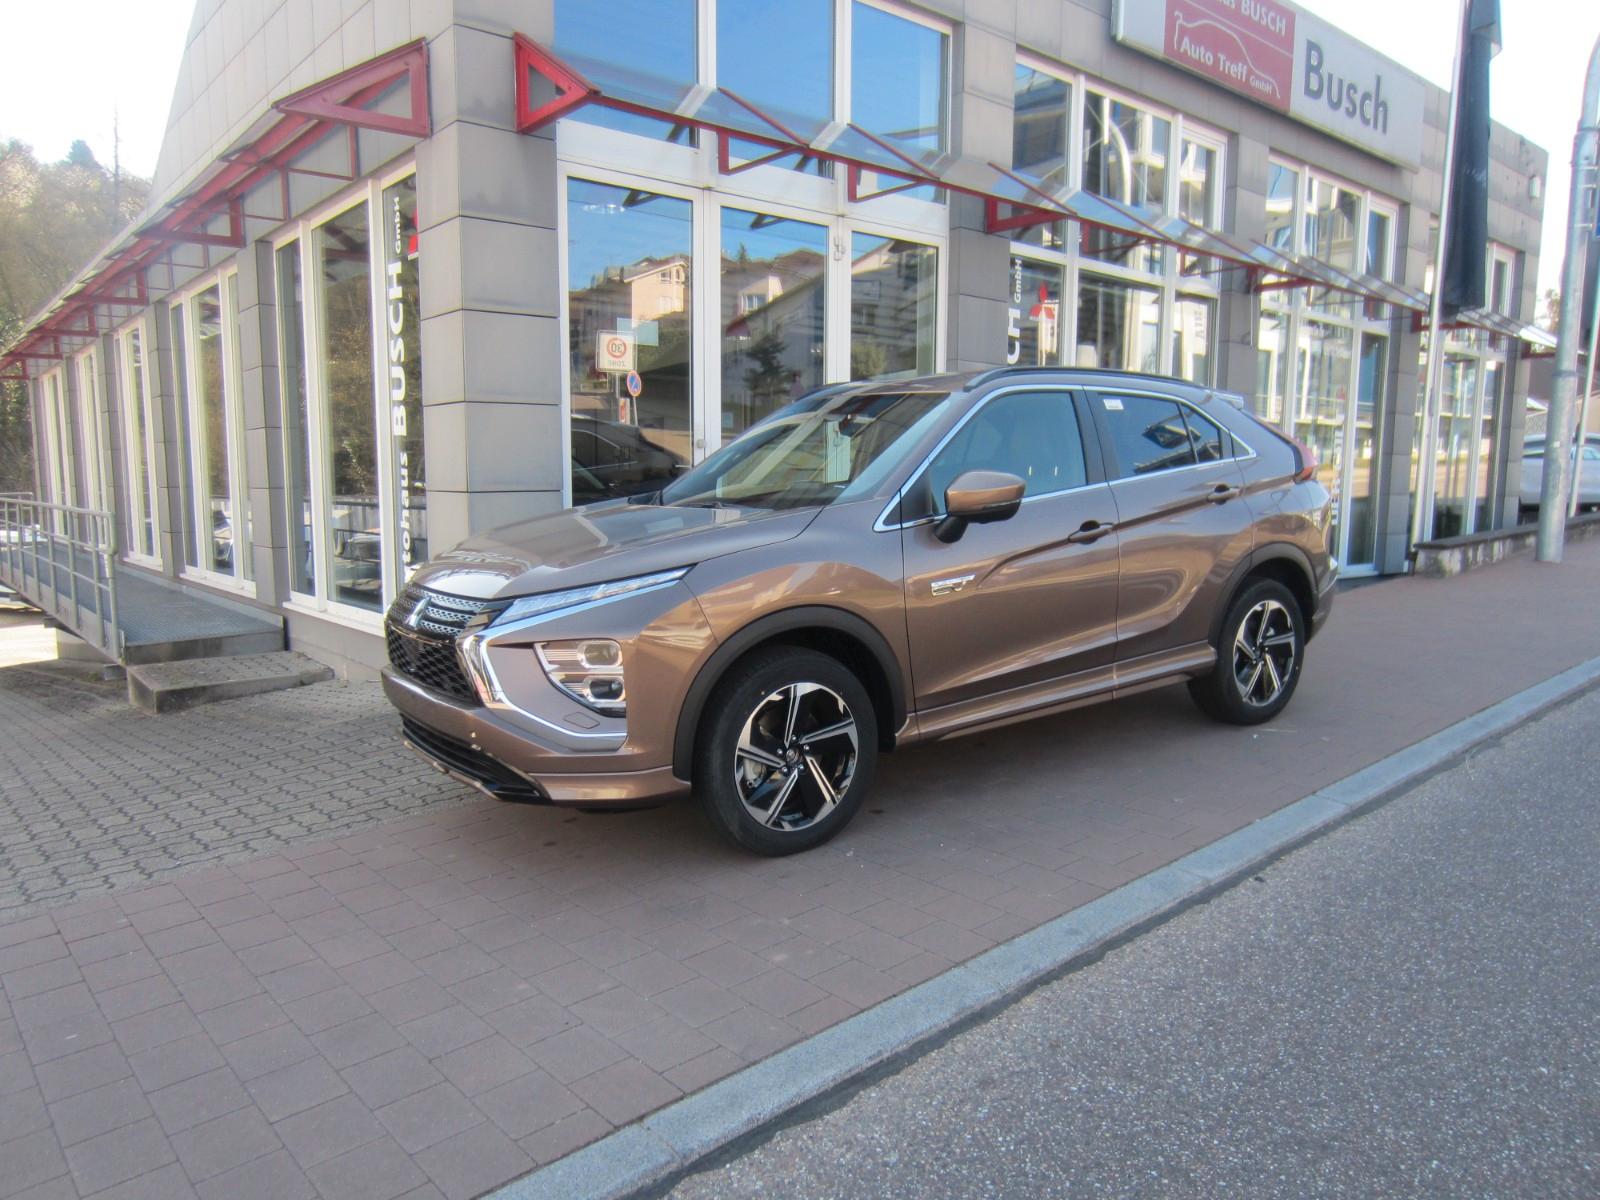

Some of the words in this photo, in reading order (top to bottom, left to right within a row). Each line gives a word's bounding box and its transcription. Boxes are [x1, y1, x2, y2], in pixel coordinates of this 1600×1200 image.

[1241, 0, 1286, 37] BUSCH
[1180, 35, 1214, 66] Auto
[1217, 52, 1248, 82] Treff
[1249, 75, 1273, 95] GmbH
[1304, 38, 1388, 134] Busch
[393, 196, 402, 255] GmbH
[388, 261, 407, 437] BUSCH
[1007, 307, 1020, 365] CH
[1014, 258, 1022, 303] GmbH
